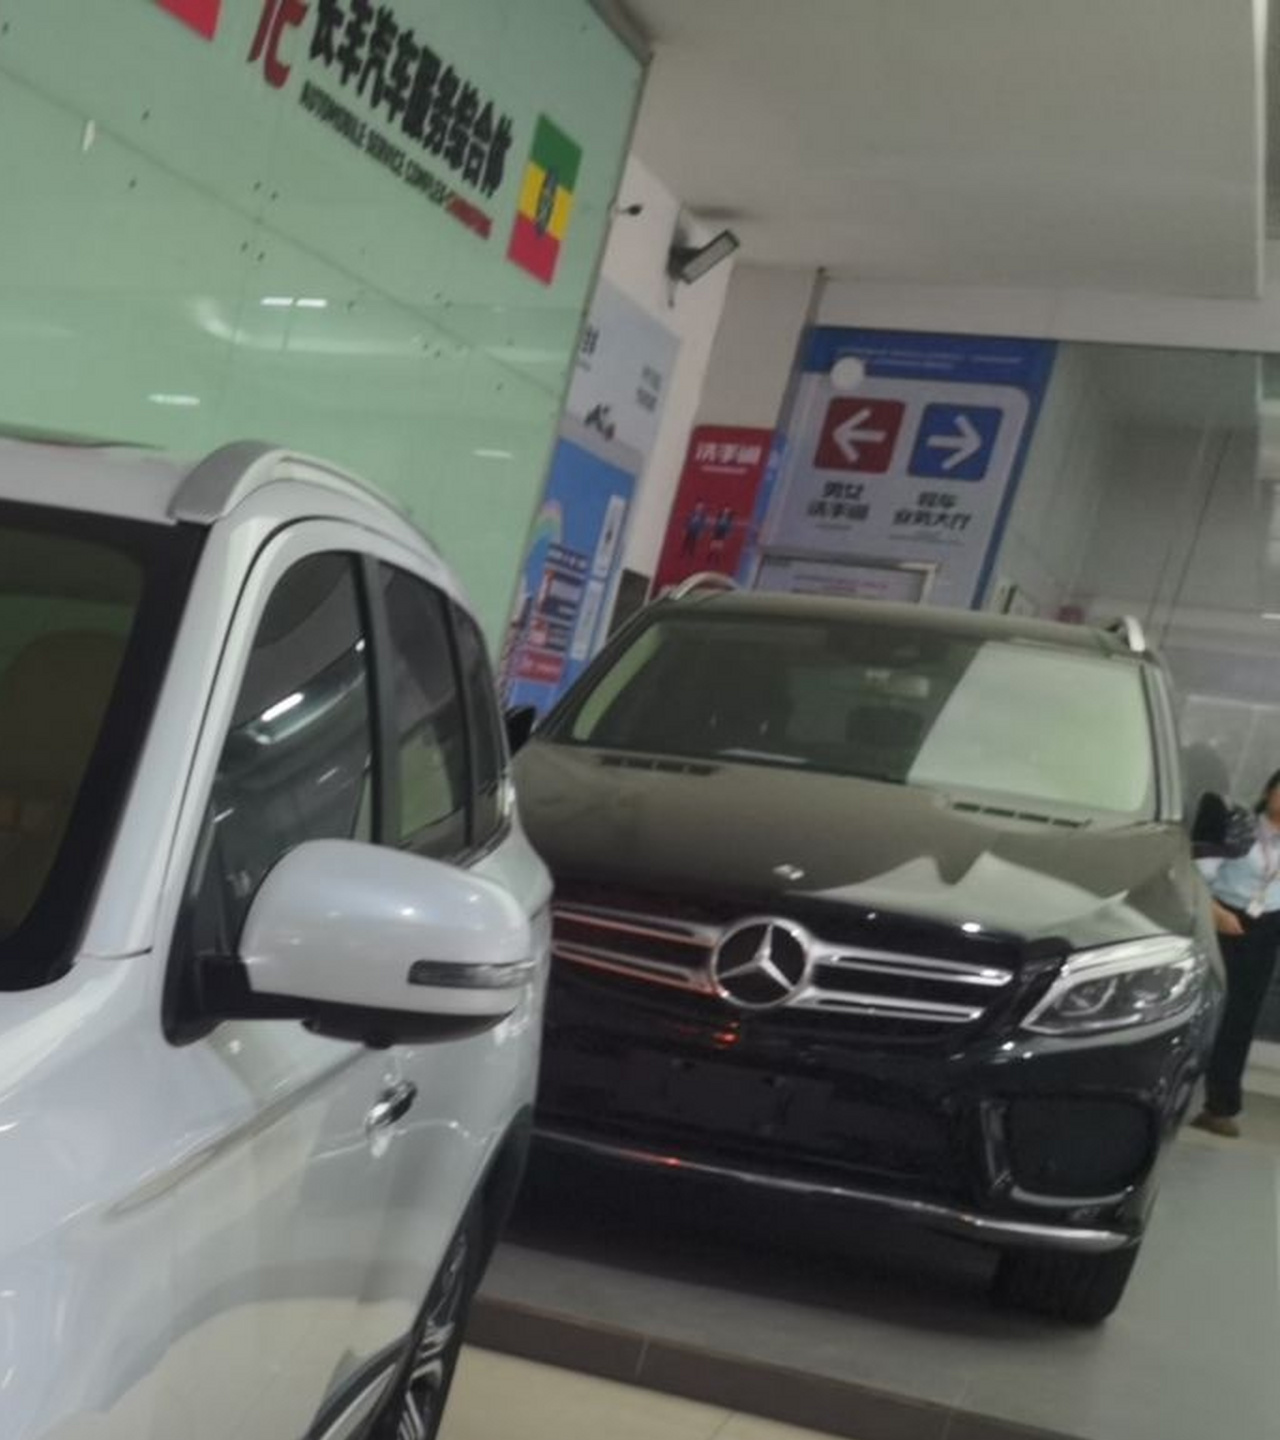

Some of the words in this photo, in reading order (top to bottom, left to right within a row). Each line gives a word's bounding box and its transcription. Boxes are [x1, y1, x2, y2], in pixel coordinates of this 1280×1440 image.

[695, 441, 762, 466] 洗手间
[822, 481, 864, 500] 男女
